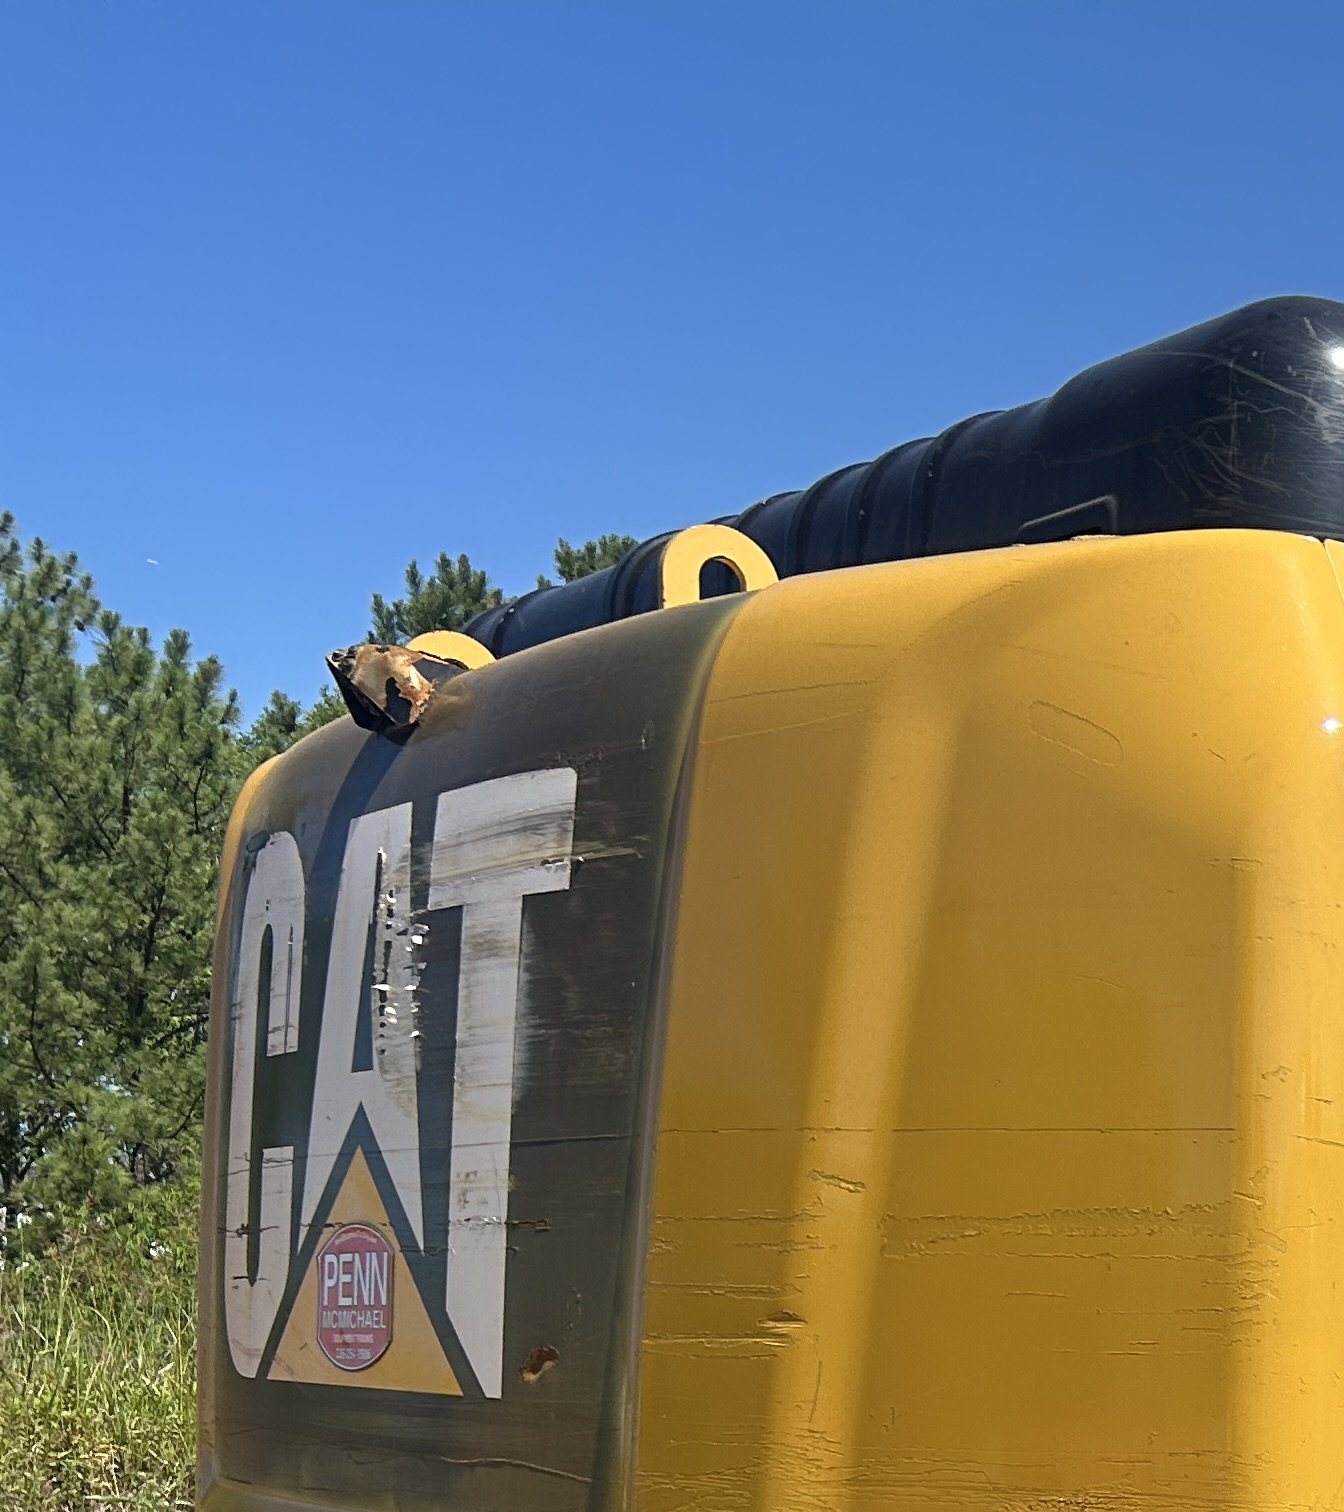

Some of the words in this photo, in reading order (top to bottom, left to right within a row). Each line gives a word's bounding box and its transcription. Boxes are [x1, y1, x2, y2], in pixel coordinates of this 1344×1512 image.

[223, 766, 578, 1400] CAT
[323, 1251, 388, 1307] PENN
[322, 1309, 387, 1329] MCMICHAEL
